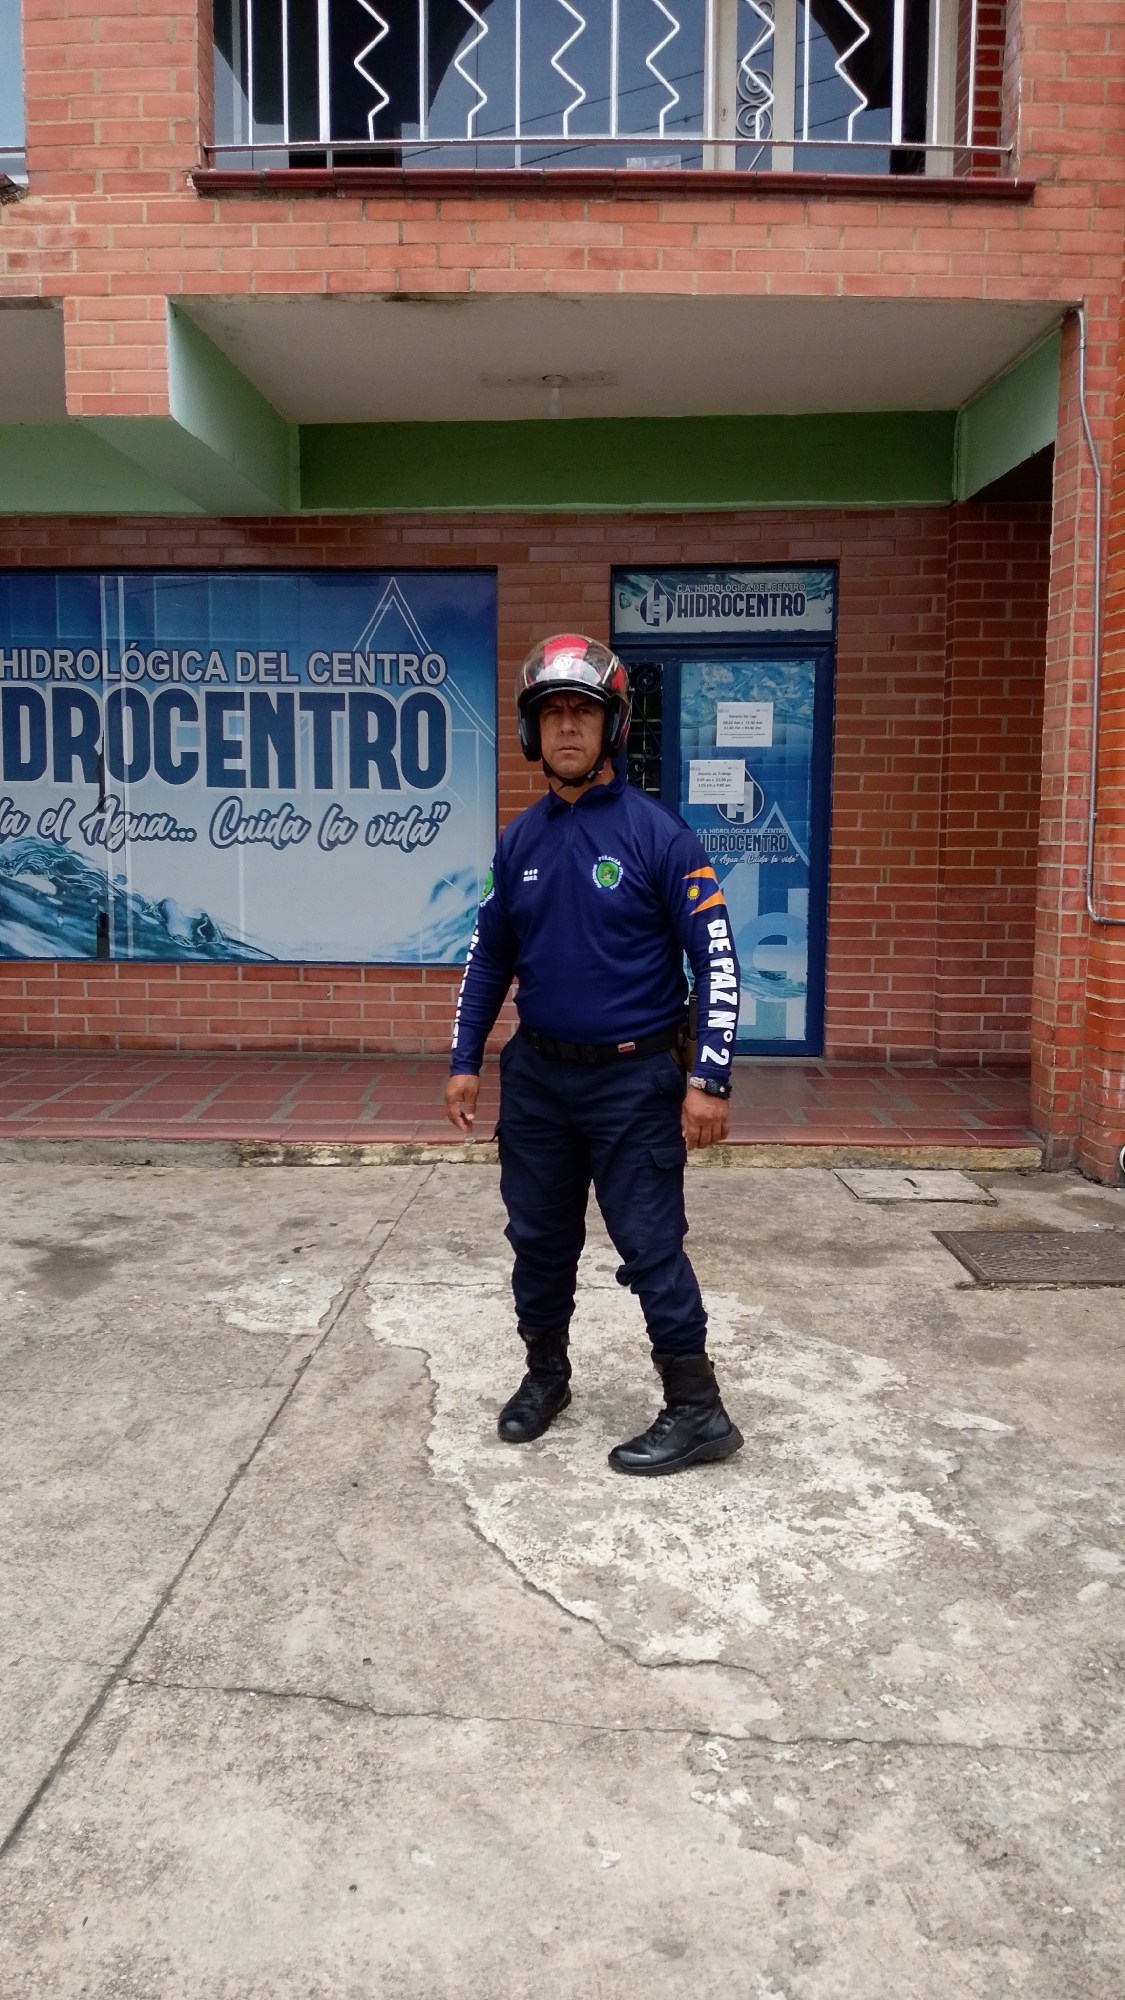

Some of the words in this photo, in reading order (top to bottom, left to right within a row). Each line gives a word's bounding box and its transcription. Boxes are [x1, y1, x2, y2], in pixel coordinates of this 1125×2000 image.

[676, 584, 693, 593] C.A.
[694, 582, 752, 592] HIDROLÓGICA
[753, 584, 769, 592] DEL
[771, 583, 806, 592] CENTRO
[676, 593, 806, 618] HIDROCENTRO
[0, 643, 228, 681] HIDROLÓGICA
[235, 651, 299, 683] DEL
[308, 651, 447, 685] CENTRO
[0, 686, 448, 791] DROCENTRO
[37, 797, 76, 846] el
[79, 794, 197, 853] Agua...
[209, 796, 312, 851] Cuida
[317, 803, 359, 852] la
[707, 919, 732, 954] DE
[709, 957, 738, 1006] PAZ
[700, 1045, 730, 1066] 2
